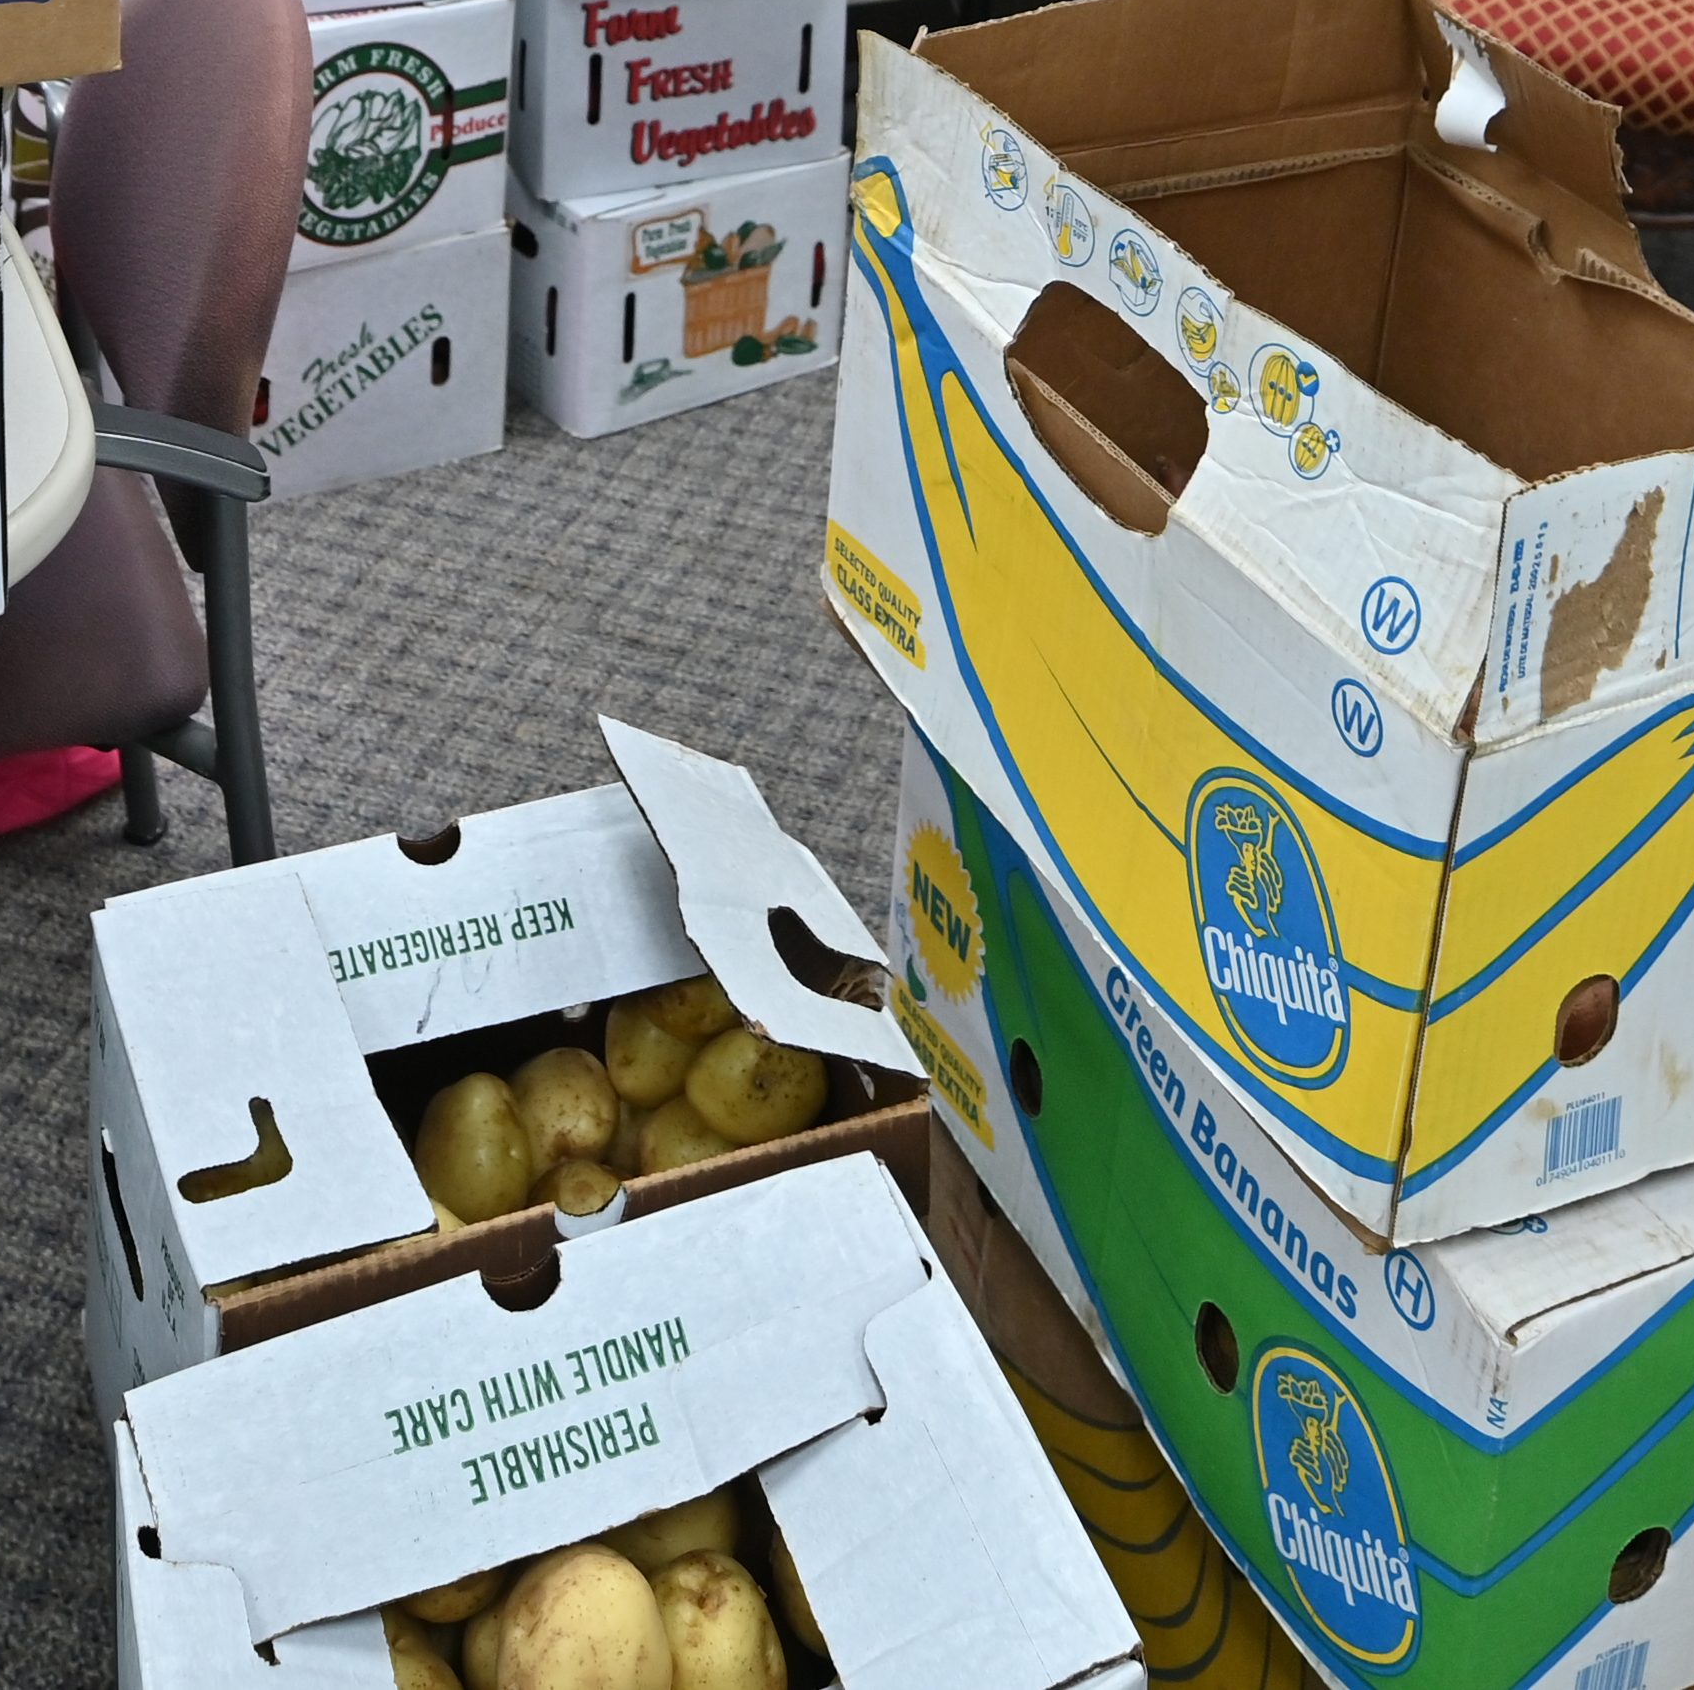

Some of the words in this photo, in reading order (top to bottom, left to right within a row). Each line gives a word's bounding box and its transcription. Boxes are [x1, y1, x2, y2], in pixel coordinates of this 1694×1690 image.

[581, 0, 683, 47] Farm
[313, 52, 359, 97] RM
[369, 47, 446, 101] FRESH
[625, 57, 735, 106] FRESH
[630, 97, 818, 168] Vegetables
[299, 170, 441, 241] EGETABLES
[257, 302, 445, 458] VEGETABLES
[301, 321, 375, 394] Fresh
[834, 537, 877, 588] SELECTED
[878, 581, 922, 629] QUALITY
[837, 564, 872, 613] CLASS
[874, 602, 916, 658] EXTRA
[1371, 594, 1414, 644] W
[1338, 694, 1376, 747] W
[510, 896, 575, 942] KEEP
[912, 860, 972, 962] NEW
[1201, 923, 1347, 1027] Chiquita
[937, 1063, 980, 1128] EXTRA
[940, 1044, 982, 1099] QUALITY
[1105, 965, 1189, 1107] Green
[1190, 1105, 1360, 1320] Bananas
[1549, 1165, 1577, 1183] 74904
[1583, 1155, 1611, 1170] 04011
[1393, 1261, 1427, 1317] H
[564, 1315, 692, 1396] HANDLE
[383, 1387, 476, 1456] CARE
[477, 1358, 567, 1424] WITH
[1487, 1396, 1507, 1431] NA
[460, 1400, 661, 1506] PERISHABLE
[1267, 1491, 1419, 1619] Chiquita
